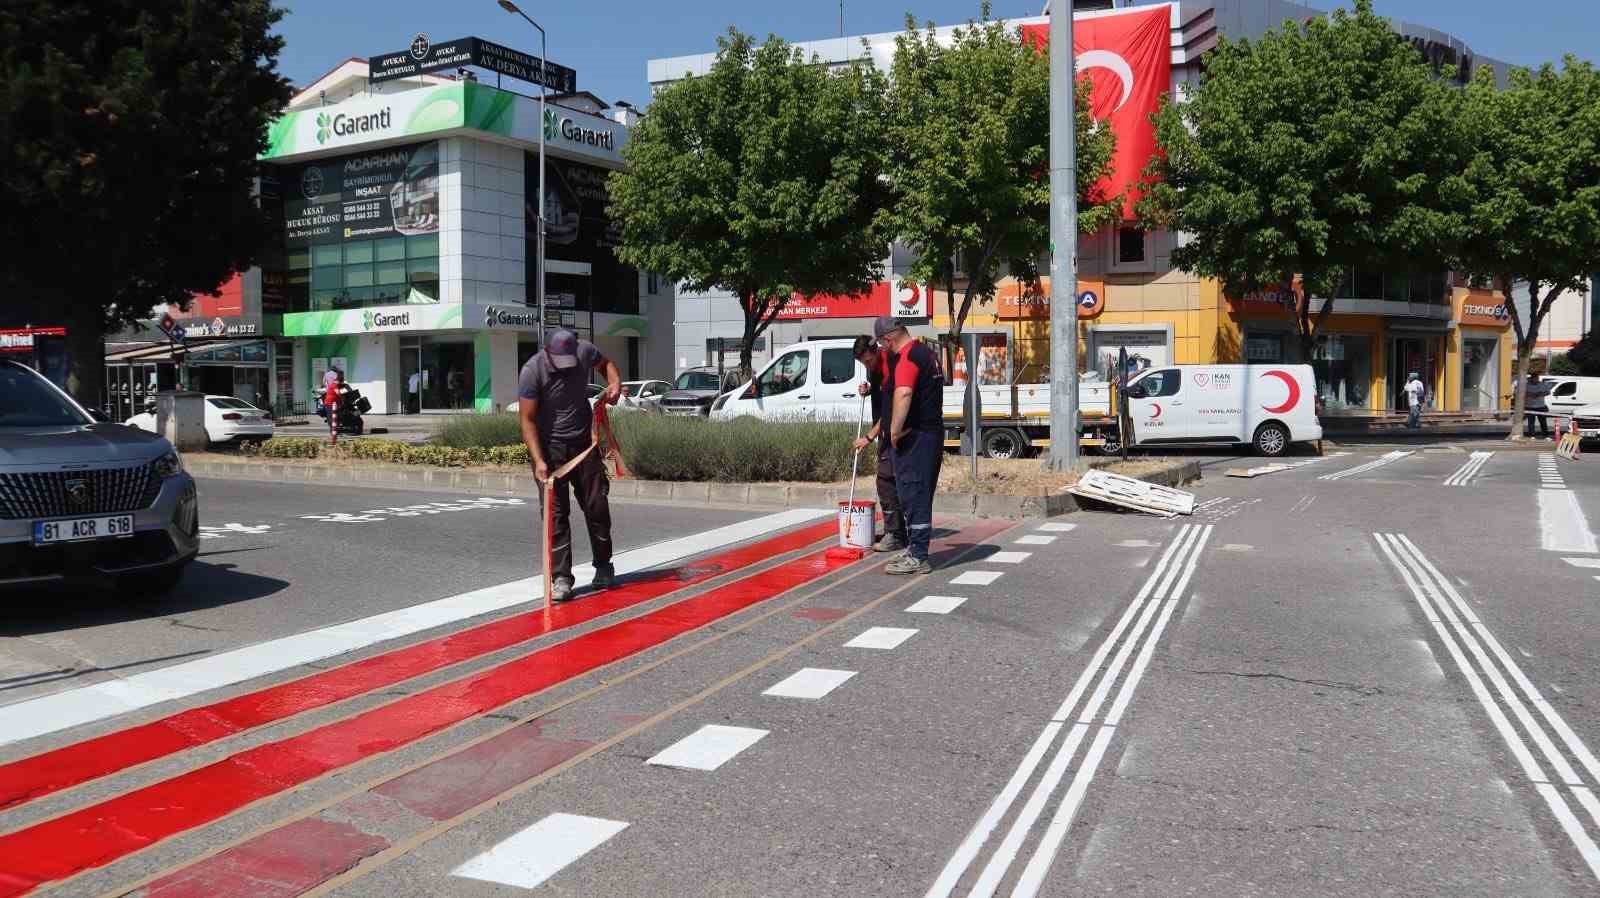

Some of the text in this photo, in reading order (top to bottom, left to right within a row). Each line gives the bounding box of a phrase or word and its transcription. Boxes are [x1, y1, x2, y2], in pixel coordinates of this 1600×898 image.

[435, 46, 456, 56] AVUKAT
[480, 42, 503, 55] AKSAY
[382, 56, 407, 66] AVUKAT
[497, 59, 527, 78] DERYA
[529, 71, 558, 87] AKAY
[333, 107, 391, 137] Garanti
[561, 119, 614, 151] Garanti
[344, 151, 409, 173] ACARHAN
[302, 206, 325, 216] AKSAY
[1463, 303, 1510, 318] TEKNOSA
[373, 312, 410, 327] Garanti
[498, 311, 535, 326] Garanti
[184, 323, 209, 336] mino's
[227, 325, 238, 333] 444
[43, 516, 131, 540] 81 ACR 618
